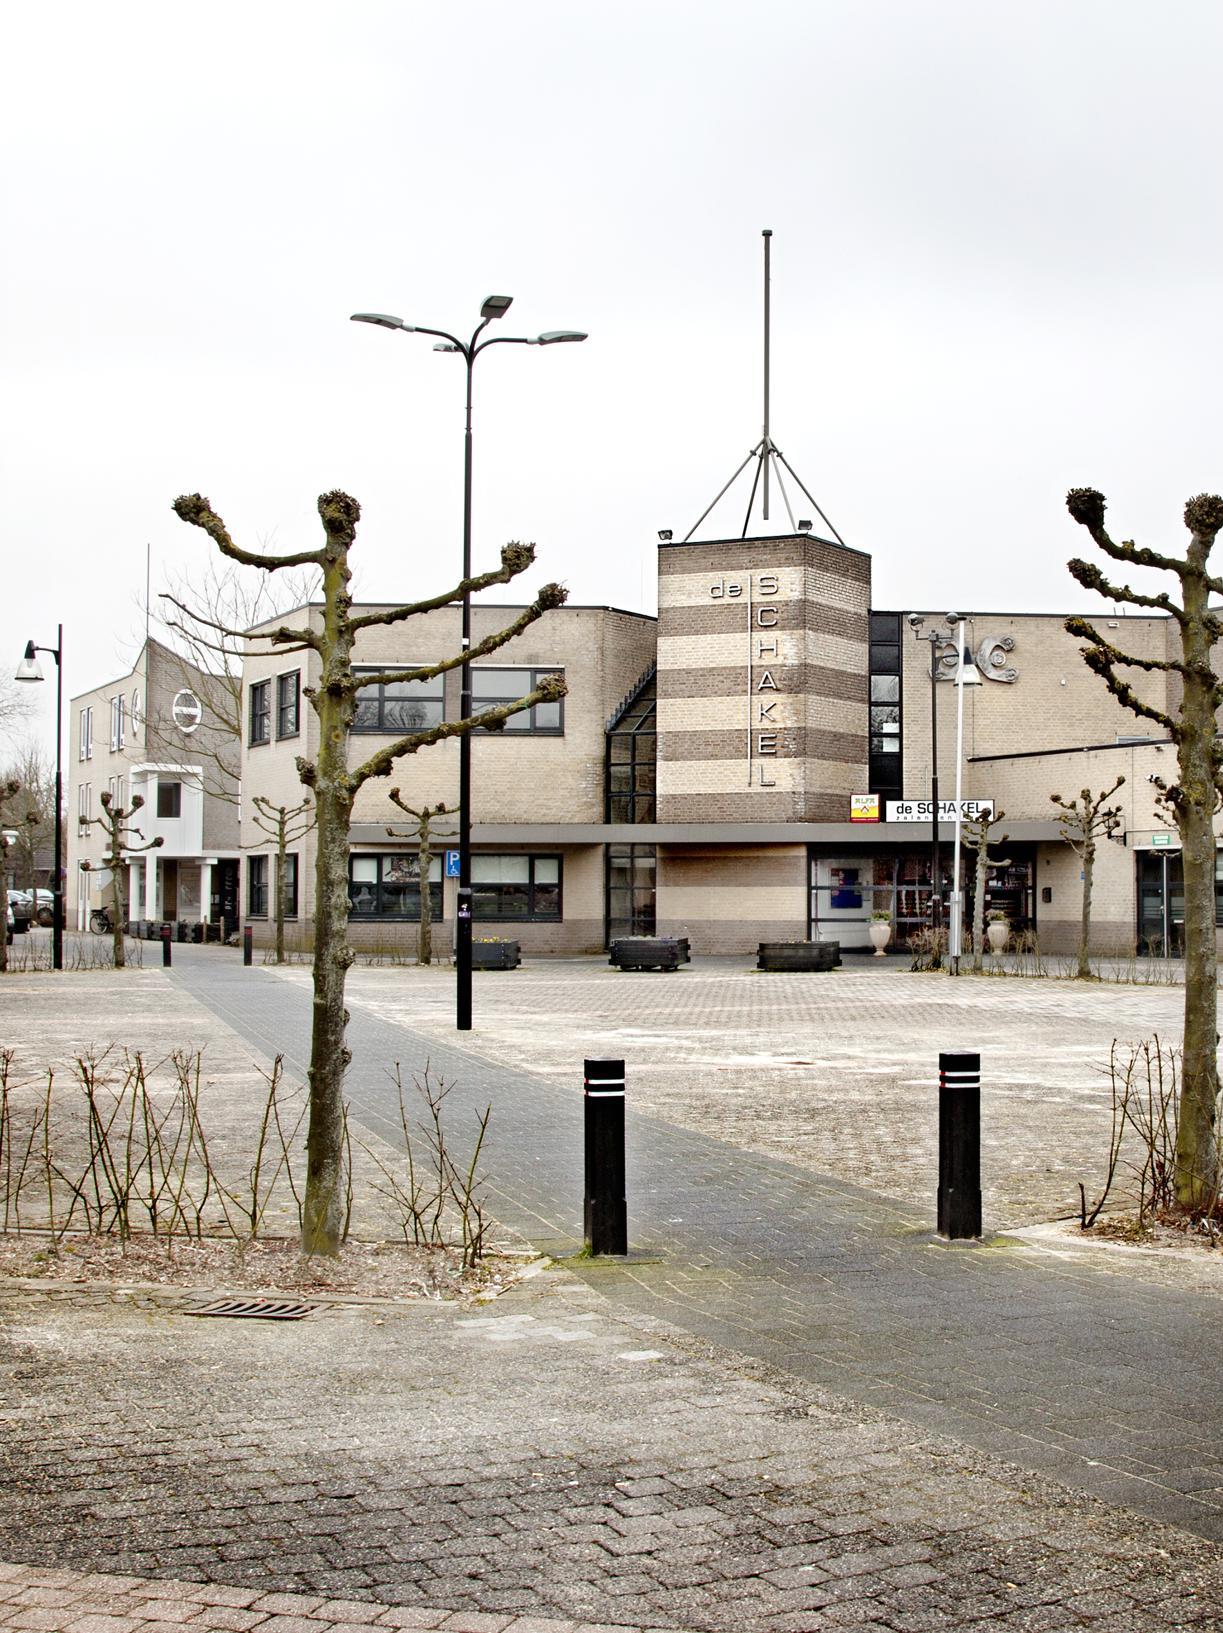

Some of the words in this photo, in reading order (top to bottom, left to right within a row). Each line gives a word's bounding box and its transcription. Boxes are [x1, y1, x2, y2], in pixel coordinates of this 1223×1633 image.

[709, 578, 742, 598] de
[757, 576, 779, 787] SCHAKEL
[896, 802, 912, 814] de
[450, 852, 460, 865] P
